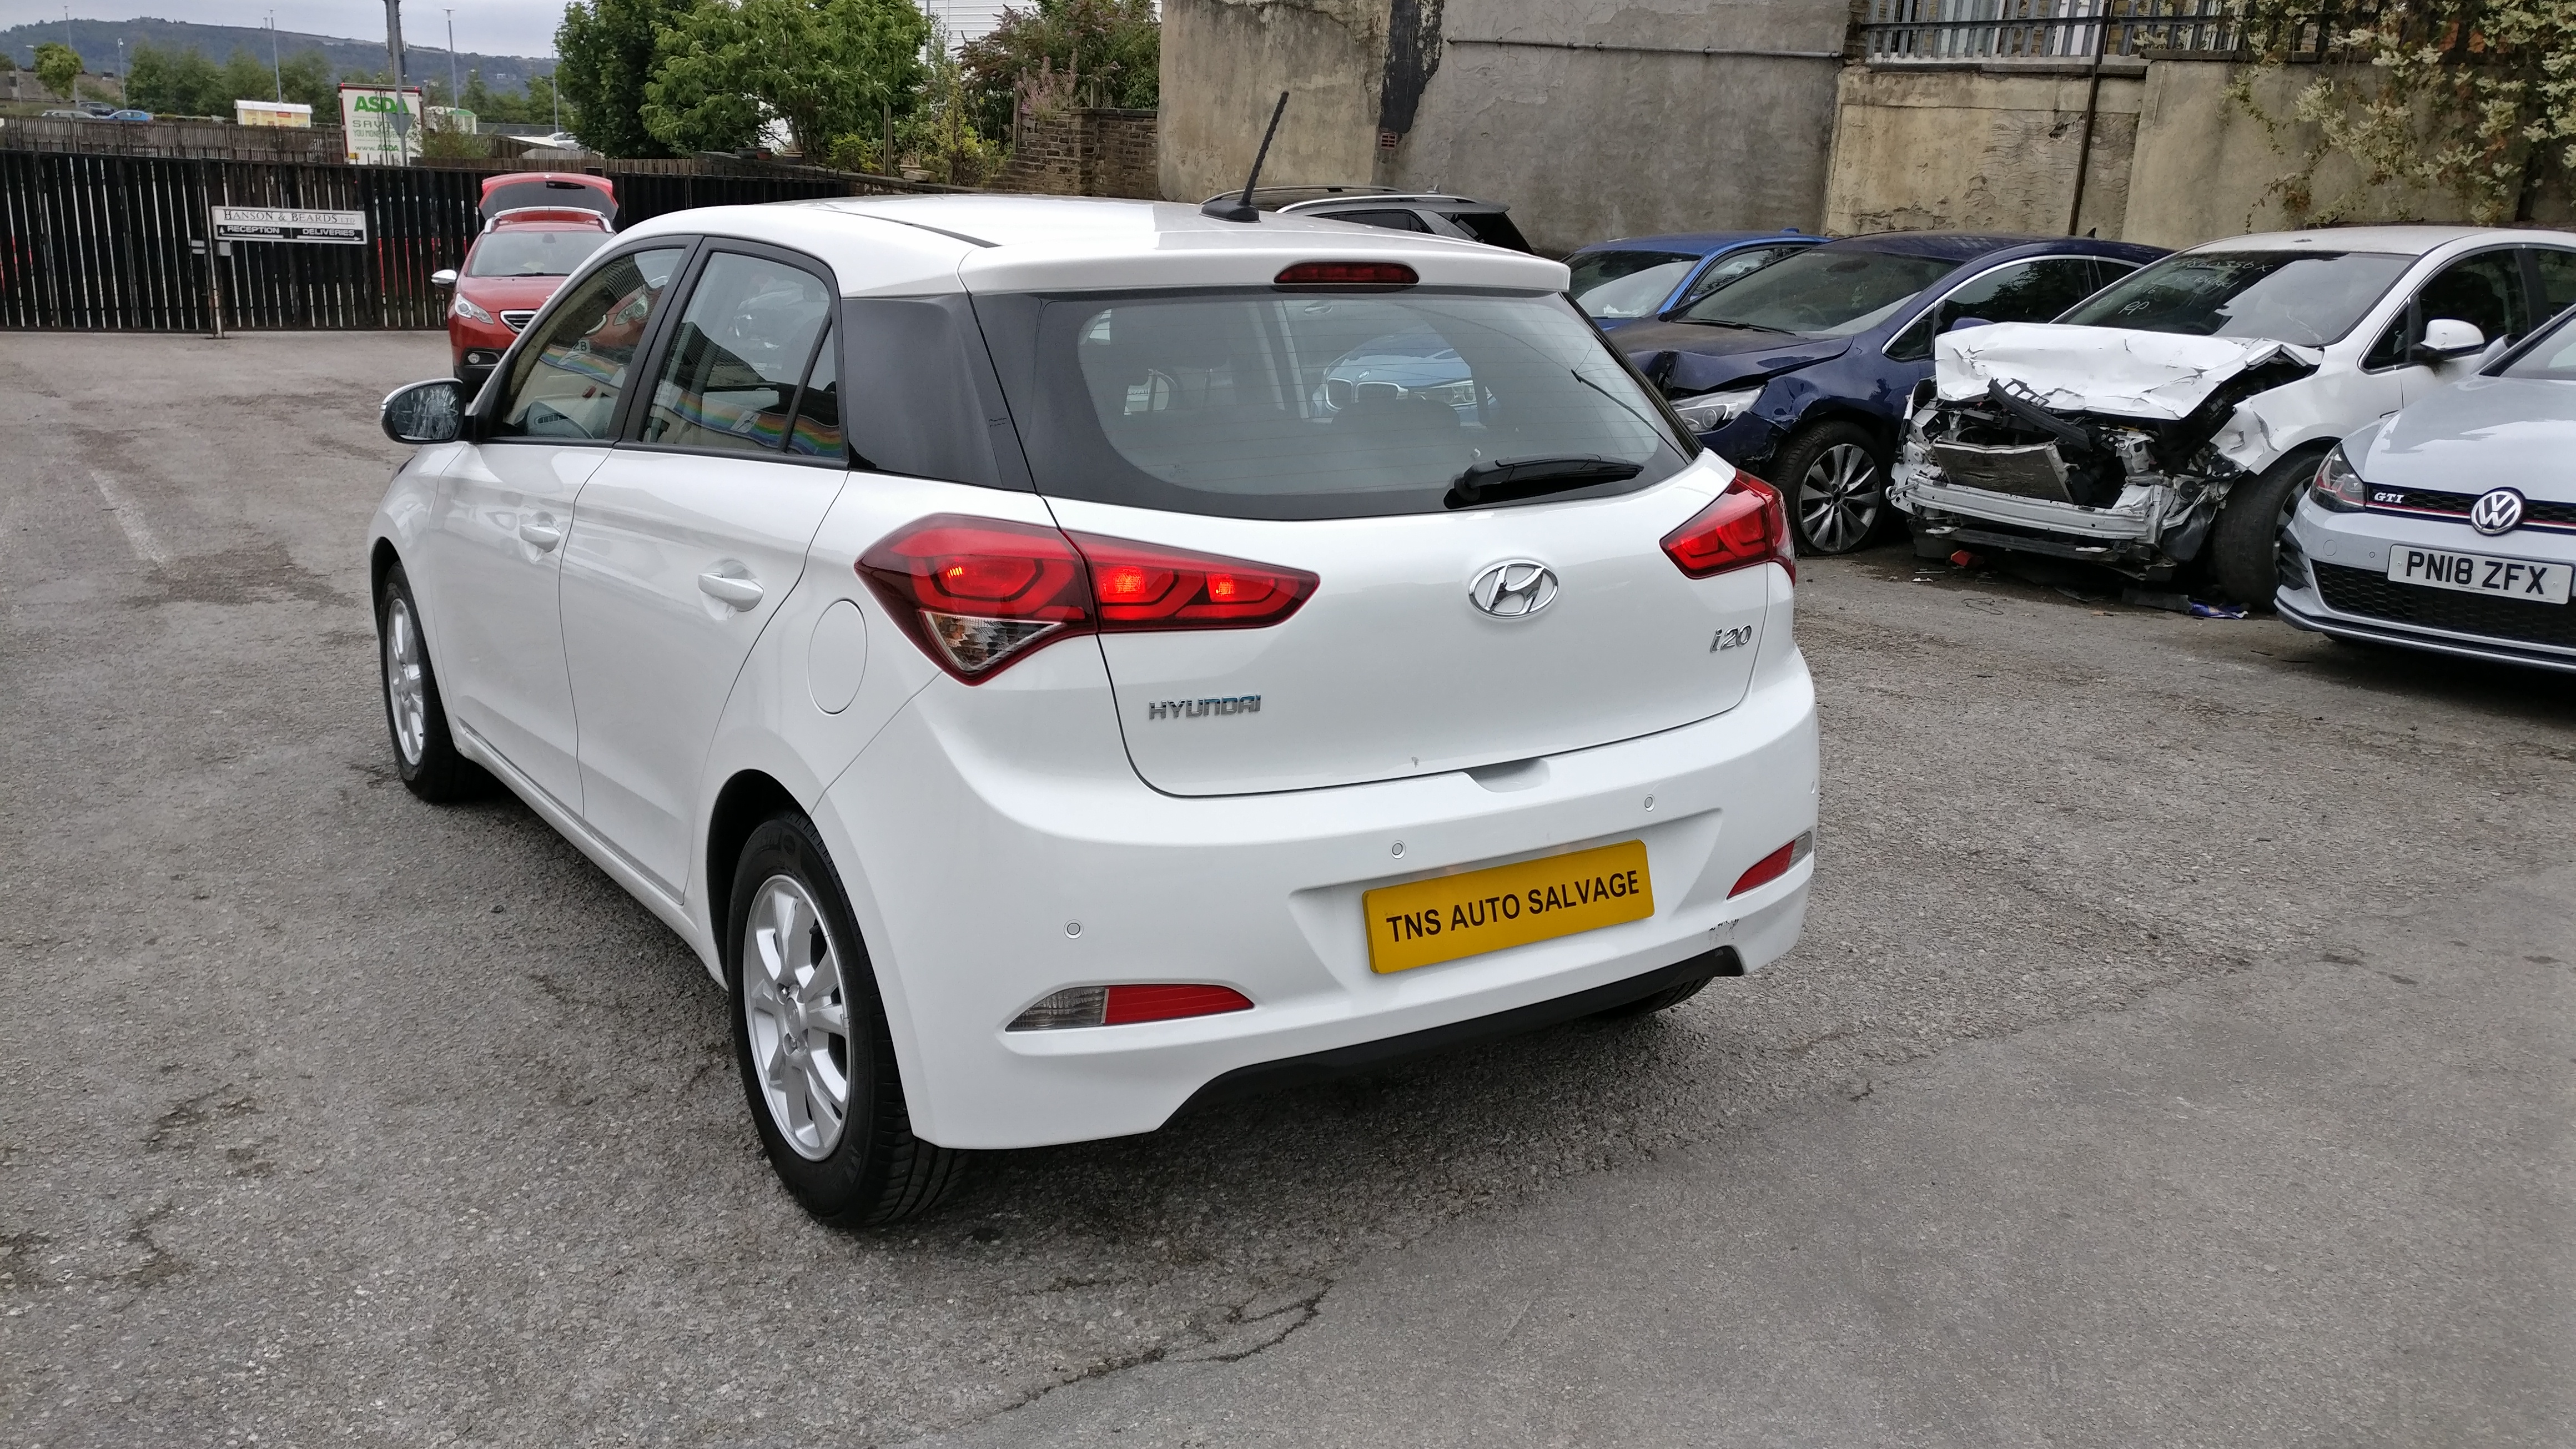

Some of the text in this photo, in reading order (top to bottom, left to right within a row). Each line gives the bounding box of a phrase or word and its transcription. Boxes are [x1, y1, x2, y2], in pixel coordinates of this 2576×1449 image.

[354, 96, 410, 114] ASDA
[224, 209, 273, 220] HANSON
[278, 213, 288, 221] &
[291, 213, 338, 223] BEARDS
[227, 225, 280, 234] RECEPTION
[302, 228, 355, 237] DELIVERIES
[2374, 492, 2404, 504] GTI
[2406, 551, 2548, 595] PN18 ZFX
[1710, 624, 1752, 653] i20
[1149, 693, 1261, 720] HYUNDAI
[1386, 870, 1639, 943] TNS AUTO SALVAGE
